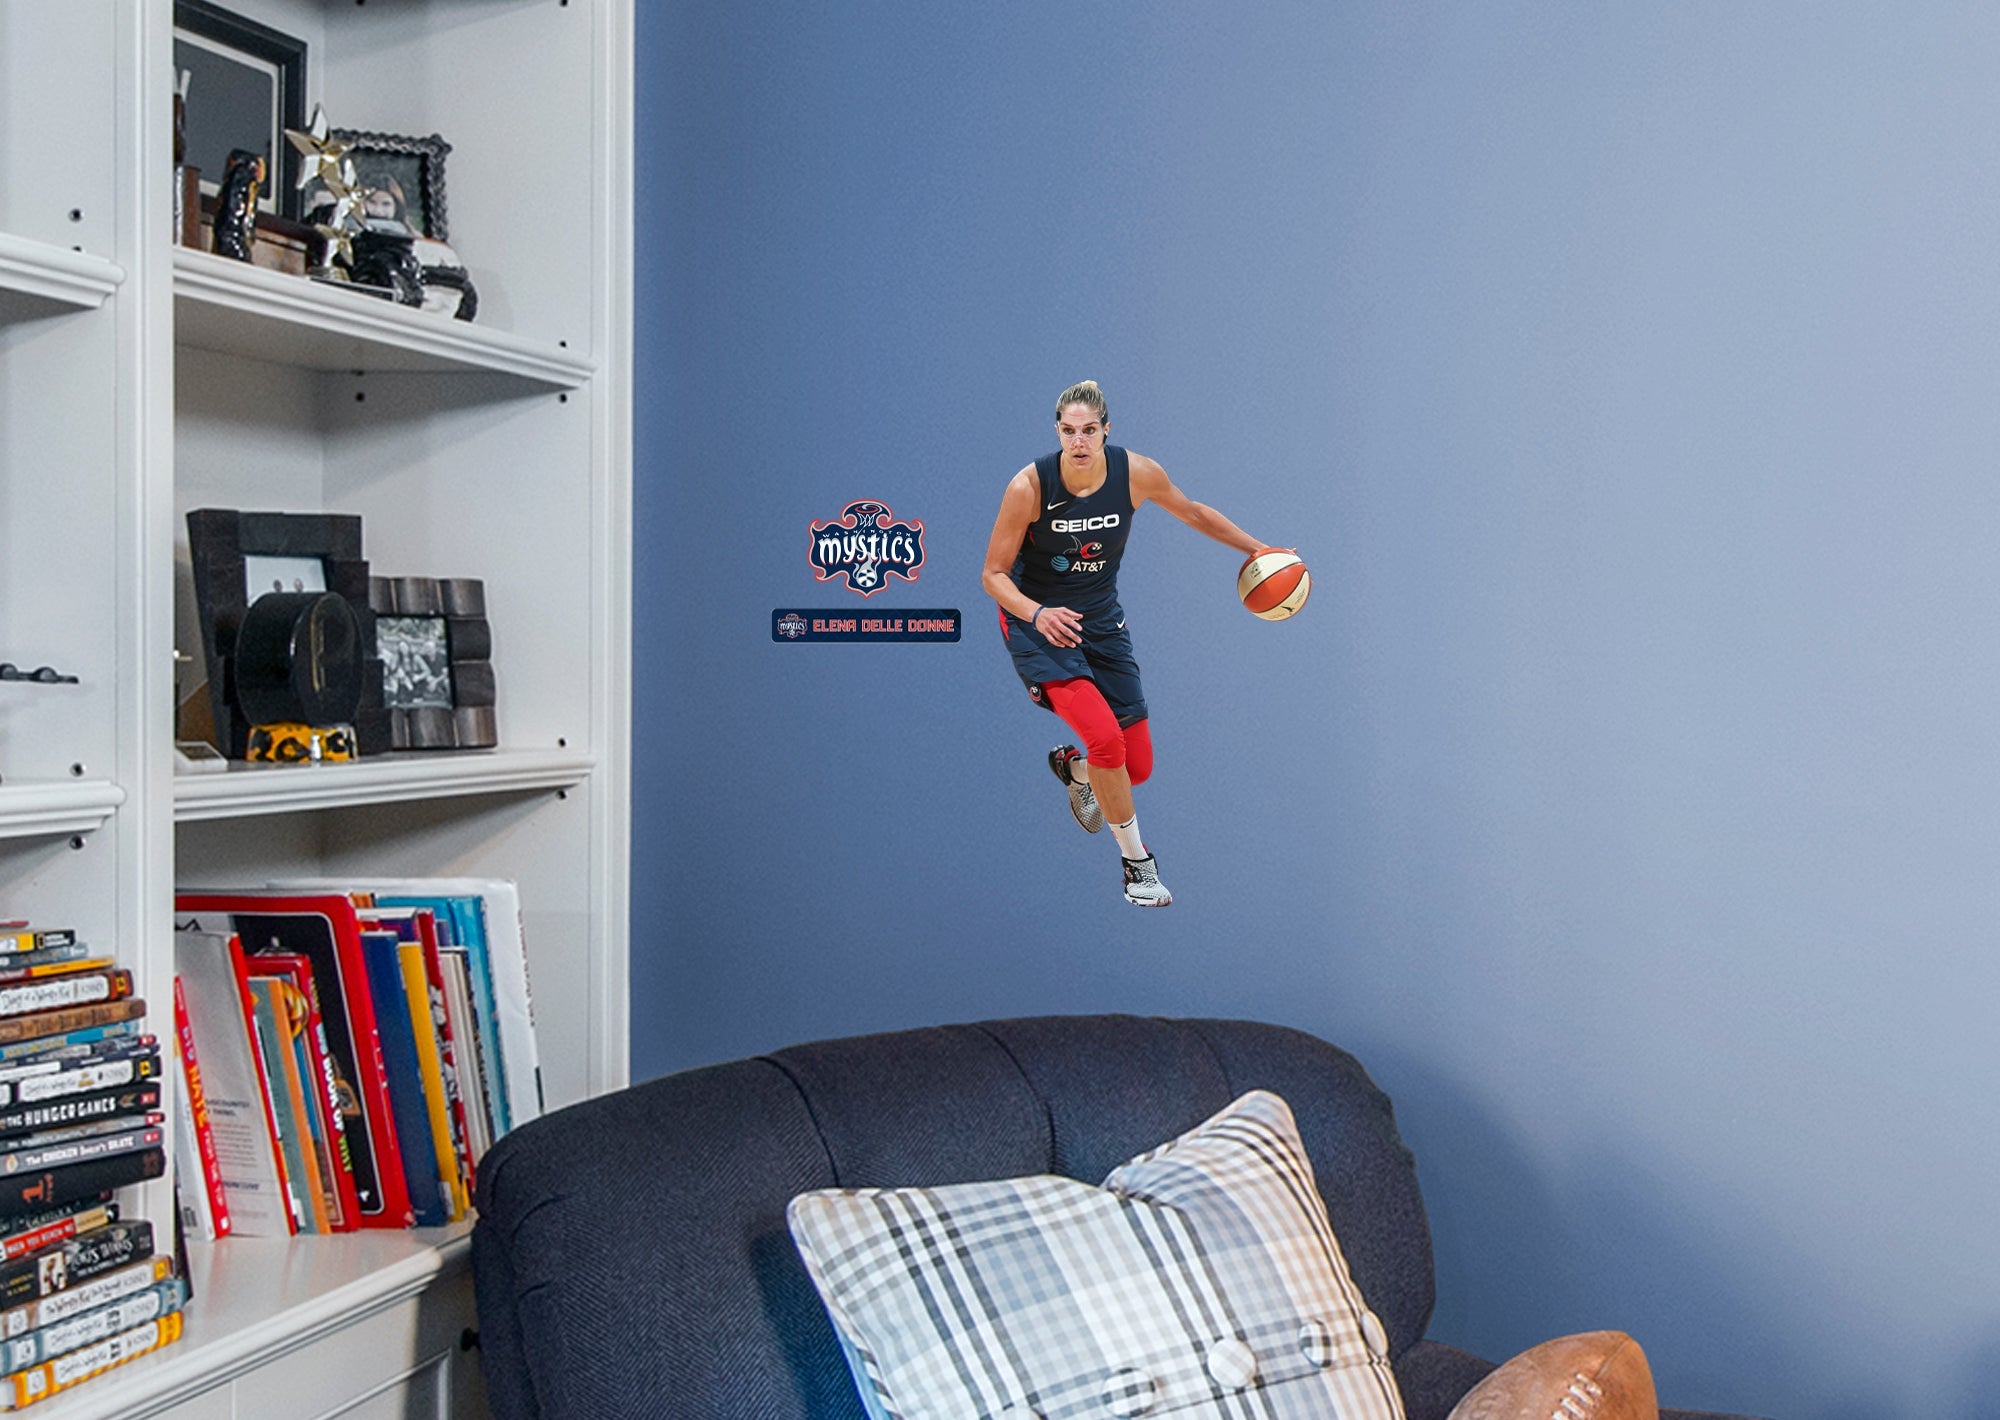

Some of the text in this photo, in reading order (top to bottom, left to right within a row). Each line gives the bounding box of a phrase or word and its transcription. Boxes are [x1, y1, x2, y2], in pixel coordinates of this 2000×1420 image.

[1051, 513, 1120, 533] GEICO
[822, 529, 911, 538] WASHINGTON
[1071, 560, 1106, 572] AT&T
[813, 619, 955, 632] ELENA DELLE DONNE
[188, 1066, 207, 1128] NATE
[7, 1096, 116, 1127] THE HUNGER GAMES
[322, 1056, 339, 1106] BOOK
[338, 1133, 352, 1173] WHY
